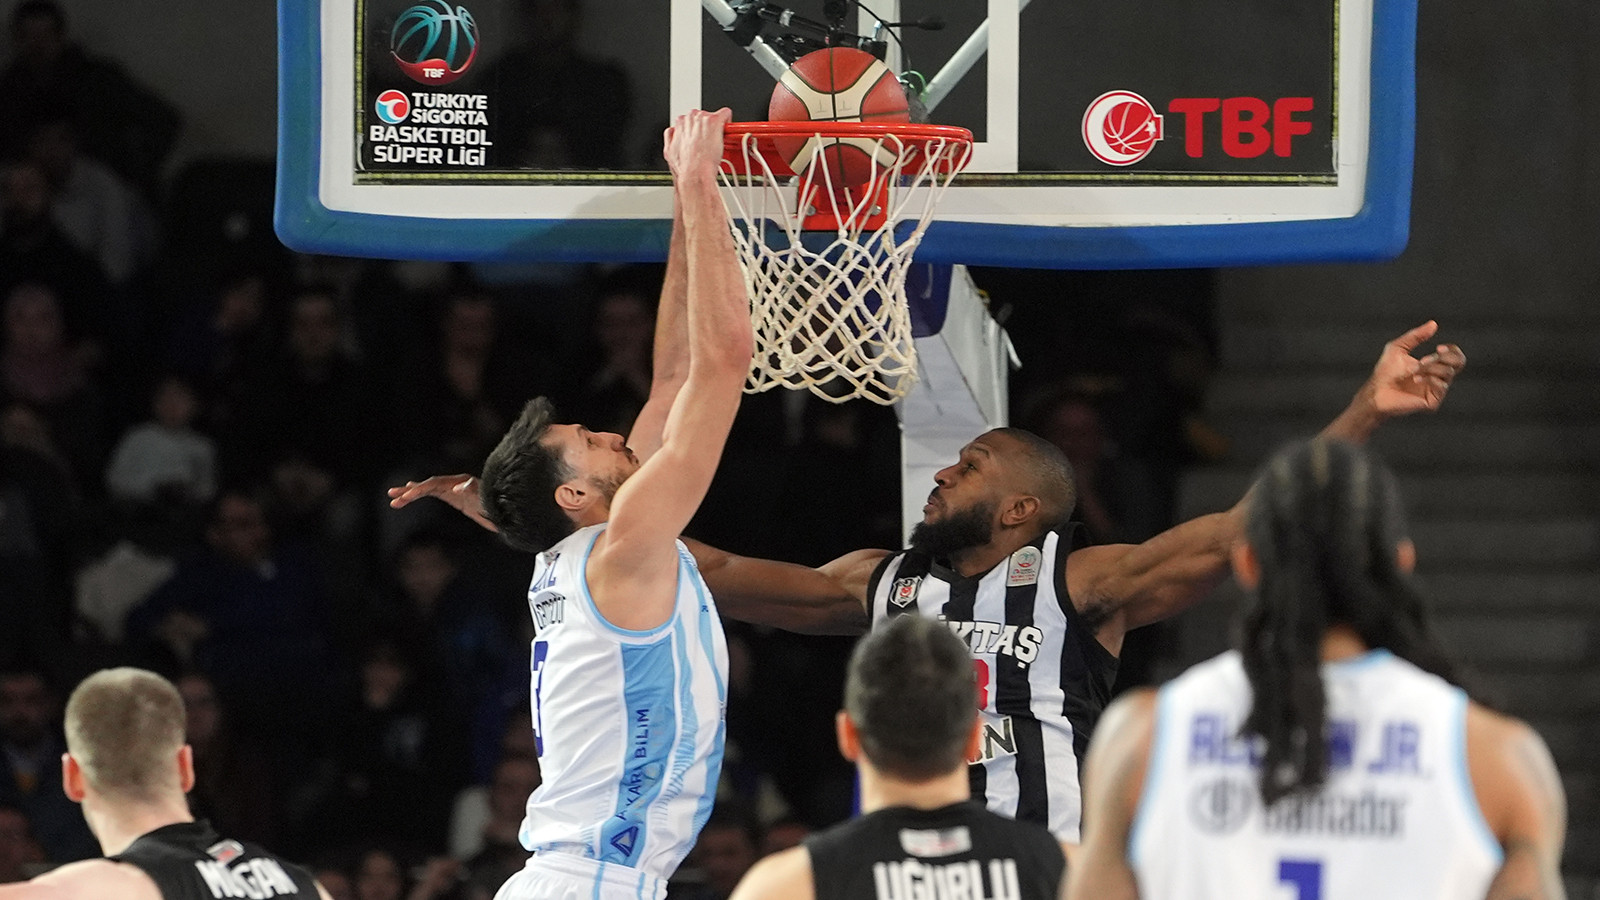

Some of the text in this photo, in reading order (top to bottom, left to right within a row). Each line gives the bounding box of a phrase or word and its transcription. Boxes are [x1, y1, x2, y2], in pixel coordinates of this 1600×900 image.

[423, 67, 445, 78] TBF
[411, 92, 488, 110] TÜRKİYE
[411, 109, 489, 126] SİGORTA
[1168, 96, 1314, 158] TBF
[370, 125, 493, 146] BASKETBOL
[373, 144, 486, 166] SÜPER LİGİ
